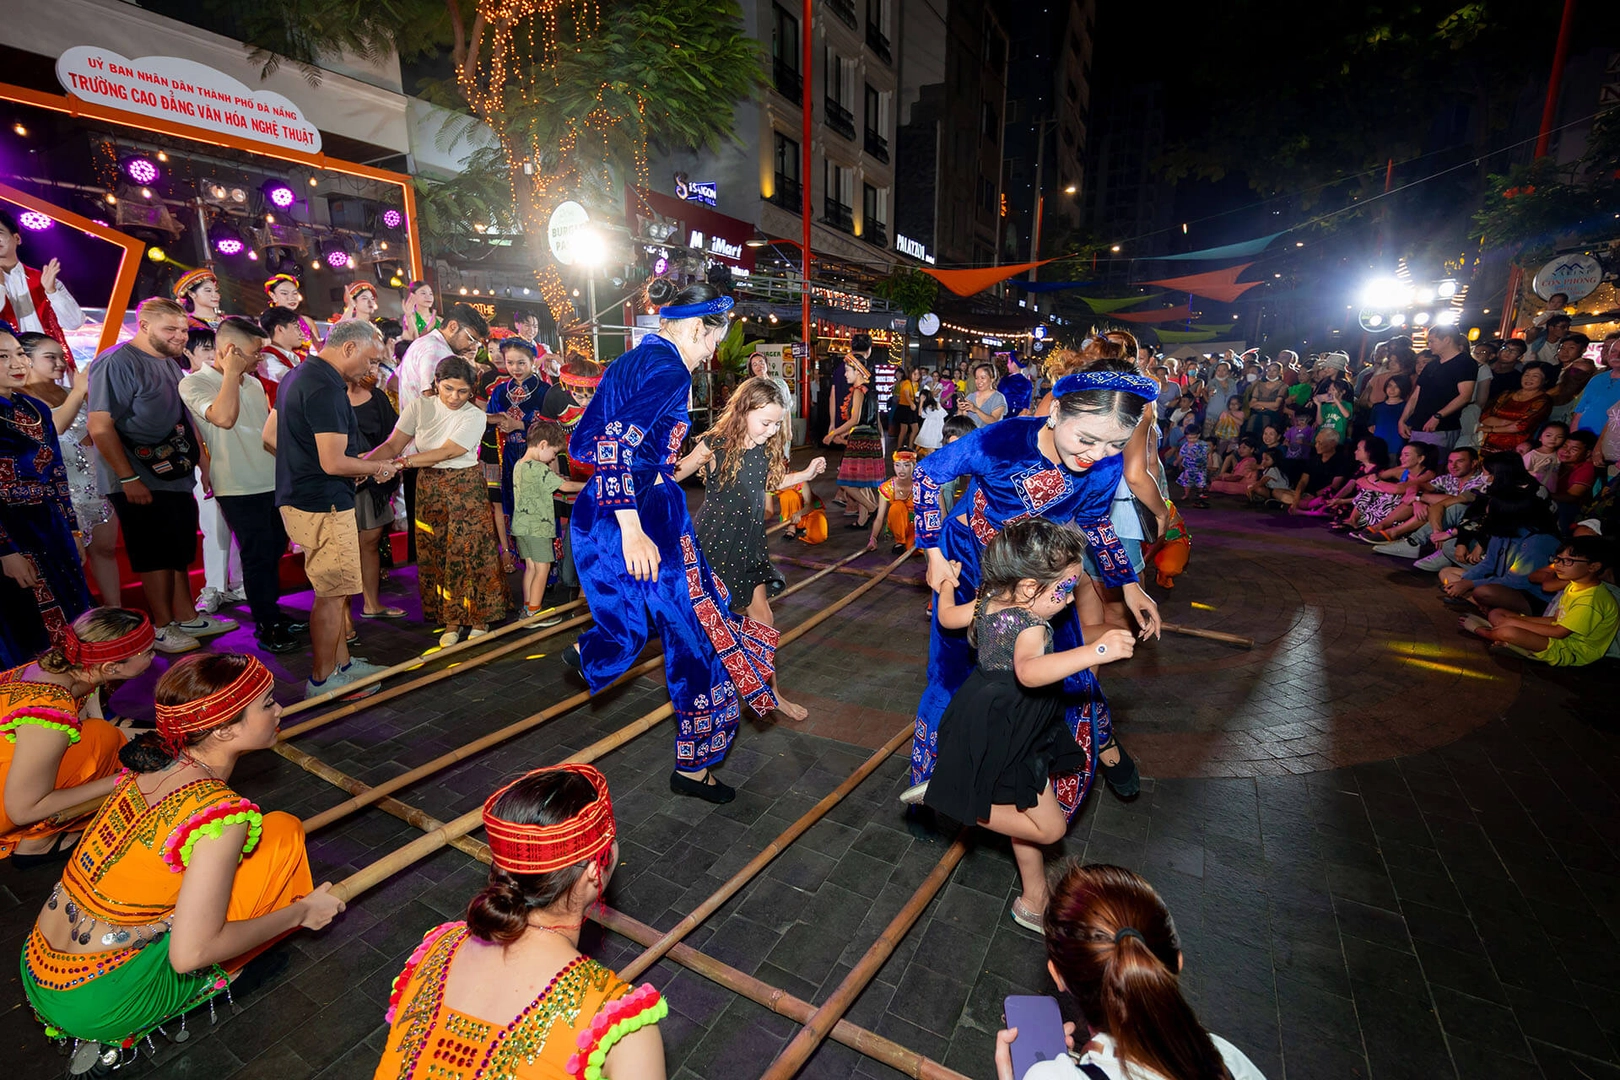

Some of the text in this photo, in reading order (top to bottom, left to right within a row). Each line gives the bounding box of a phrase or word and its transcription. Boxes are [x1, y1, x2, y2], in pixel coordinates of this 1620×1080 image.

[68, 72, 314, 146] TRƯỜNG CAO ĐẲNG VĂN HÓA NGHỆ THUẬT
[88, 56, 104, 70] UỶ
[109, 63, 134, 78] BAN
[137, 70, 168, 87] NHÂN
[171, 79, 195, 94] DÂN
[196, 86, 232, 103] THÀNH
[234, 97, 254, 109] PHỐ
[257, 102, 270, 113] ĐÀ
